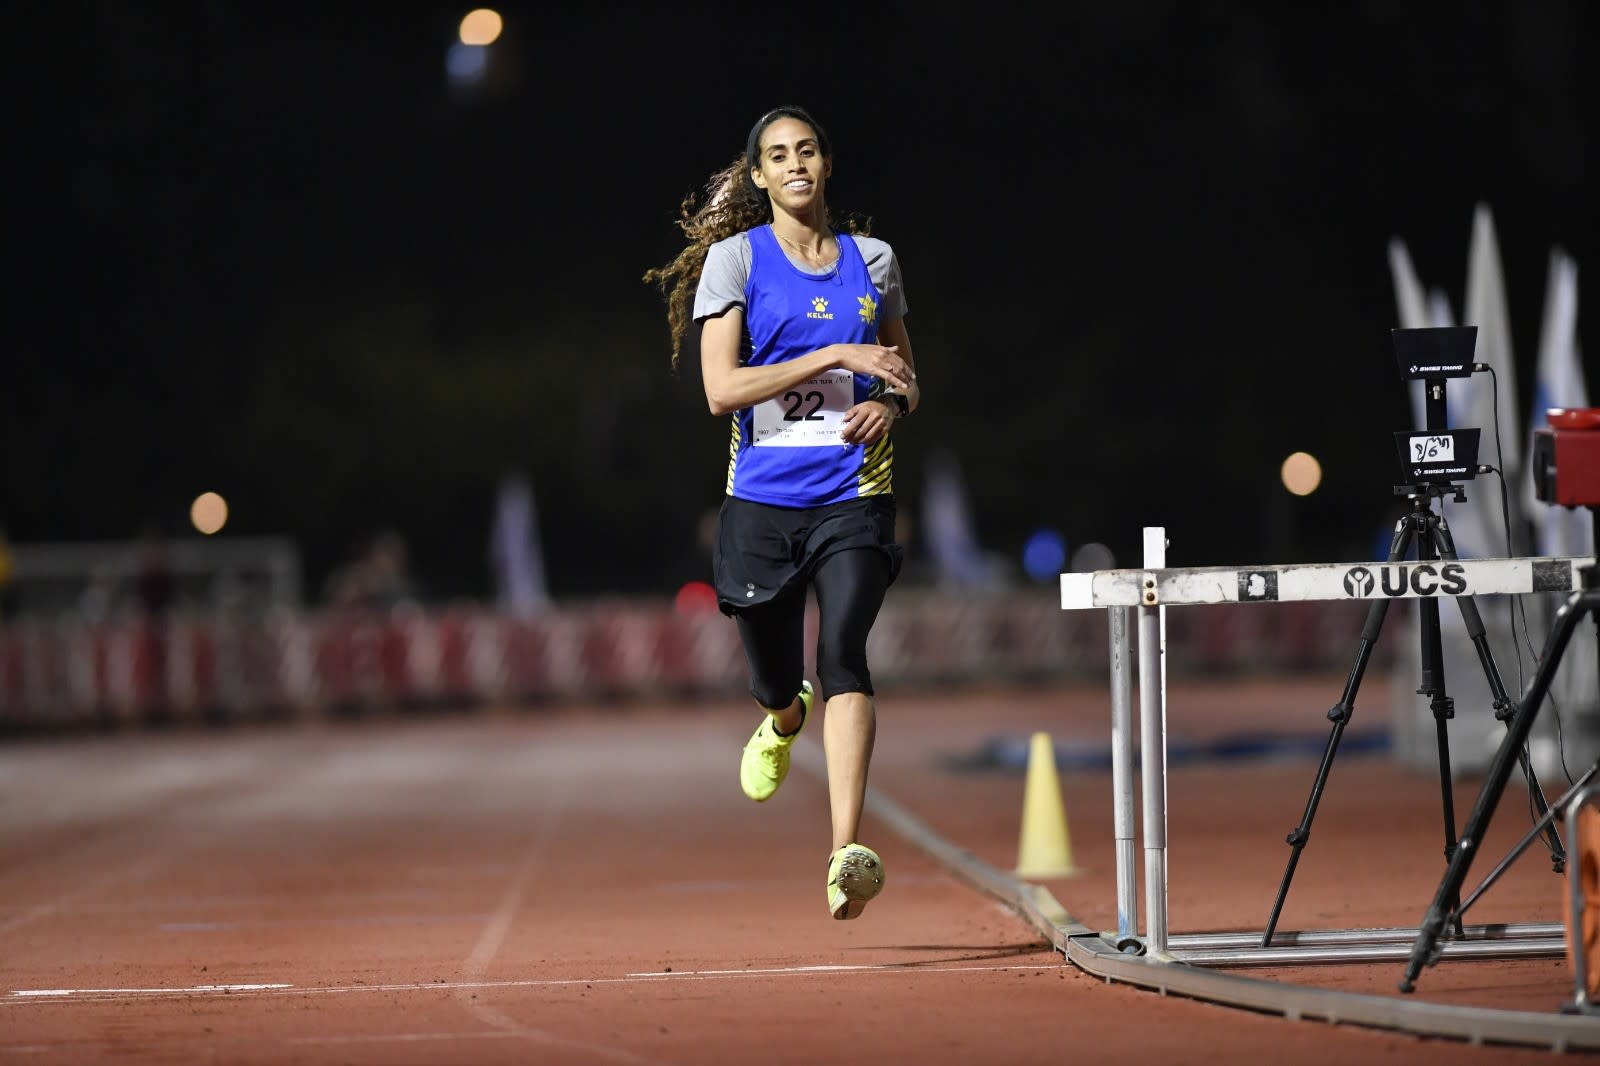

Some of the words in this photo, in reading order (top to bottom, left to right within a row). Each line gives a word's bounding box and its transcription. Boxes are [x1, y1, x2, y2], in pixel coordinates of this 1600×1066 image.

[807, 312, 834, 320] KELME
[783, 390, 825, 422] 22
[1380, 563, 1467, 597] UCS
